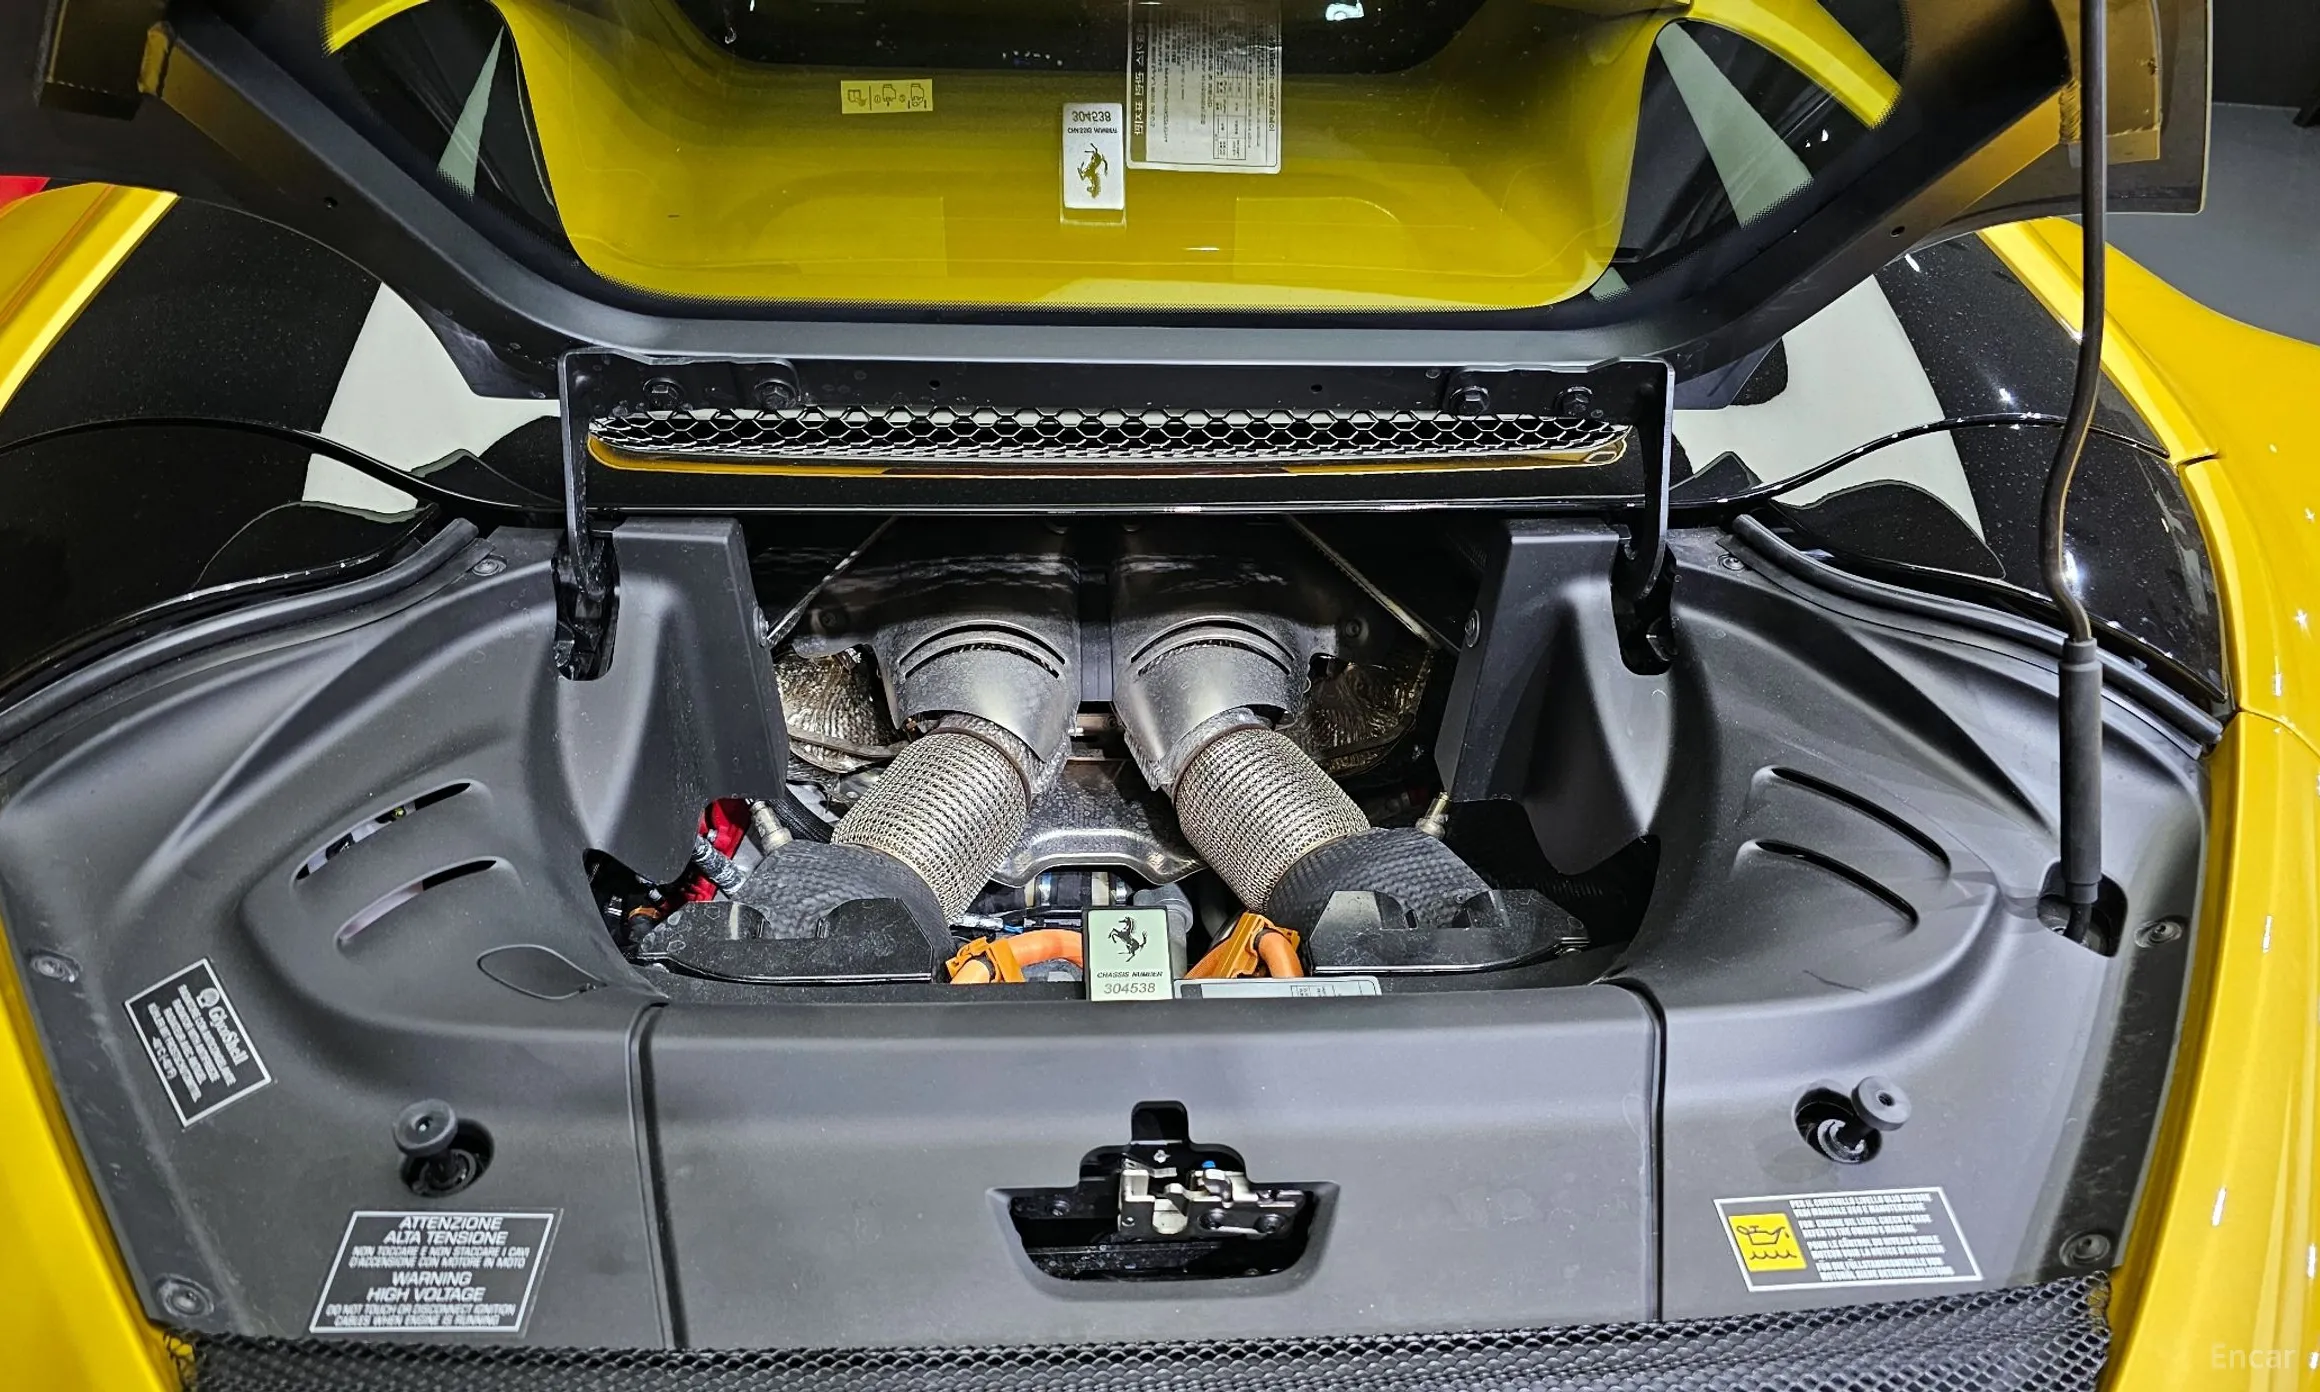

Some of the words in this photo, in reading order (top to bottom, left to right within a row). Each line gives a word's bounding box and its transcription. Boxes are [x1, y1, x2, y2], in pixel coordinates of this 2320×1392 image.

[1104, 983, 1156, 994] 304538
[399, 1216, 503, 1230] ATTENZIONE
[383, 1231, 421, 1245] ALTA
[426, 1231, 508, 1245] TENSIONE
[392, 1271, 472, 1286] WARNING
[366, 1287, 410, 1302] HIGH
[413, 1287, 486, 1302] VOLTAGE
